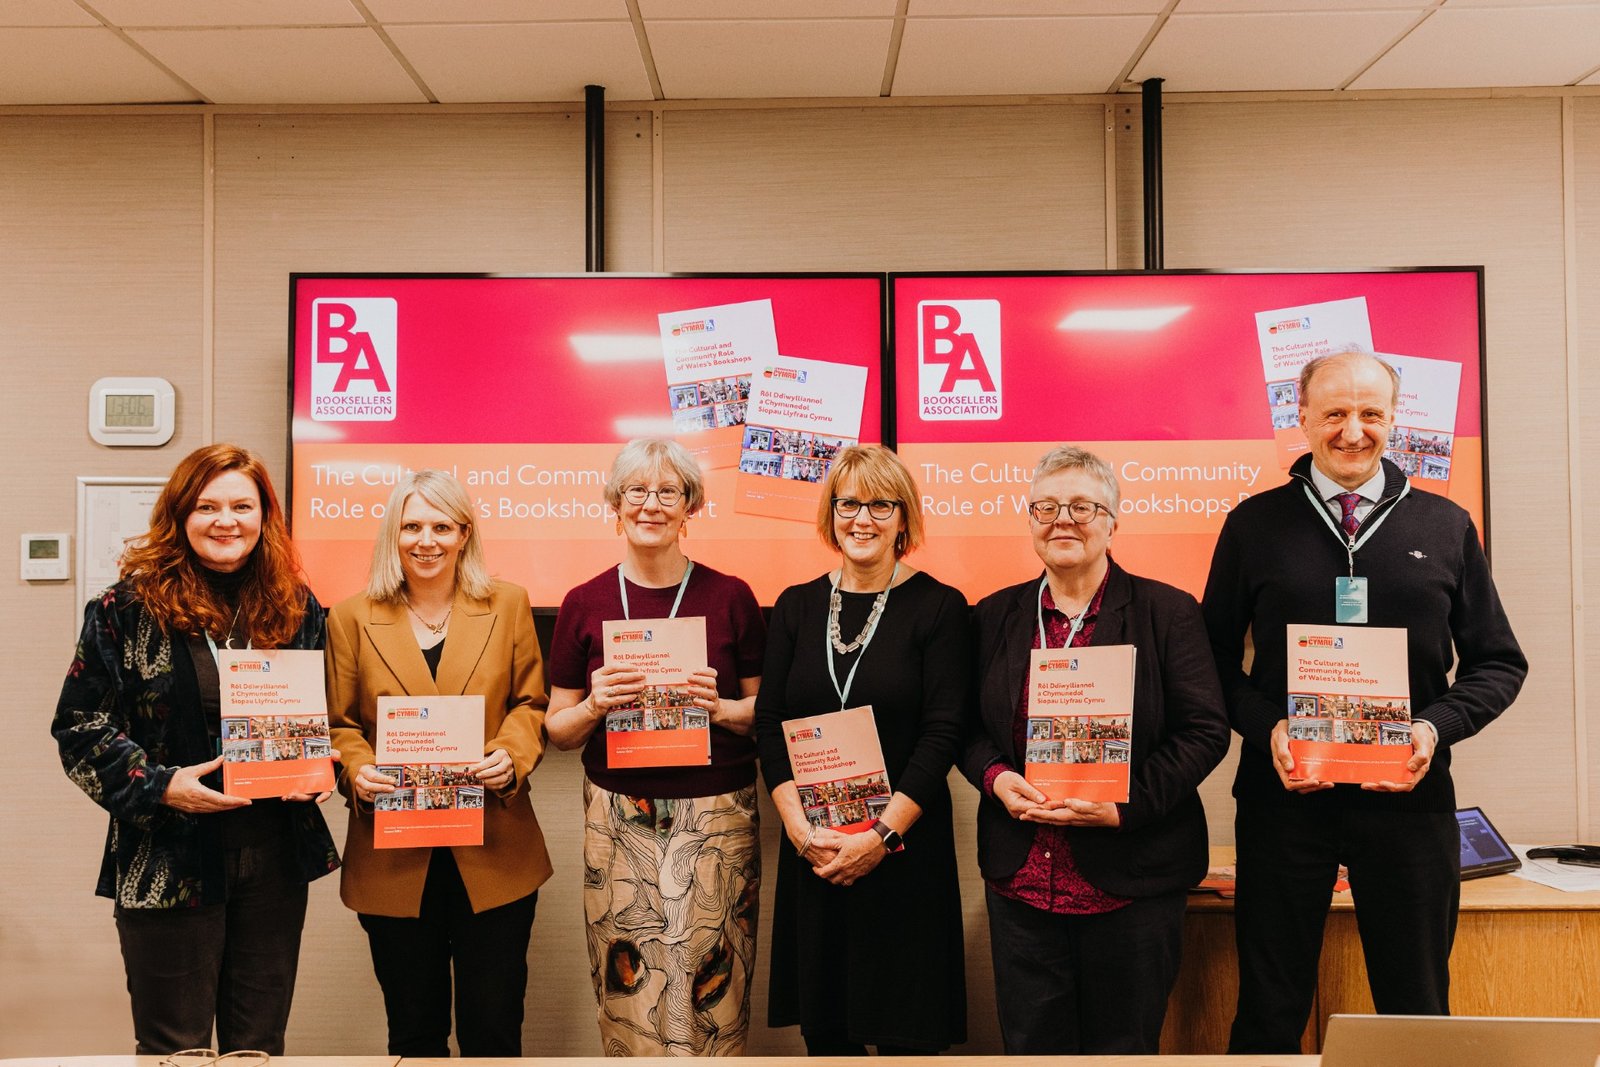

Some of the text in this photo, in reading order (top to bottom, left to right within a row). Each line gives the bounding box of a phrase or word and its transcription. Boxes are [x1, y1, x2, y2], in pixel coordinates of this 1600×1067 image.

[317, 303, 391, 392] BA
[688, 343, 718, 353] Cultural
[922, 305, 997, 392] BA
[1286, 341, 1313, 351] Cultural
[1273, 349, 1313, 360] Community
[713, 356, 752, 366] Bookshops
[316, 396, 392, 405] BOOKSELLERS
[773, 391, 823, 405] Ddiwylliannol
[923, 396, 998, 405] BOOKSELLERS
[765, 399, 810, 411] Chymunedol
[923, 405, 998, 415] ASSOCIATION
[316, 406, 392, 415] ASSOCIATION
[758, 406, 833, 421] Siopau Llyfrau Cymru
[1405, 408, 1428, 416] Cymru
[310, 464, 355, 486] The
[467, 465, 510, 486] and
[921, 463, 963, 484] The
[970, 463, 1035, 483] Cultu
[1121, 461, 1262, 487] Community
[310, 497, 365, 519] Role
[371, 503, 386, 519] o
[499, 497, 617, 525] Bookshop
[921, 496, 974, 516] Role
[980, 495, 1004, 516] of
[1119, 493, 1232, 519] ookshops
[1308, 639, 1333, 647] CYMRU
[1313, 659, 1344, 667] Cultural
[1298, 666, 1342, 675] Community
[1337, 676, 1379, 685] Bookshops
[803, 750, 825, 759] Cultural
[795, 757, 825, 767] Community
[803, 765, 822, 773] Wales's
[823, 760, 857, 771] Bookshops
